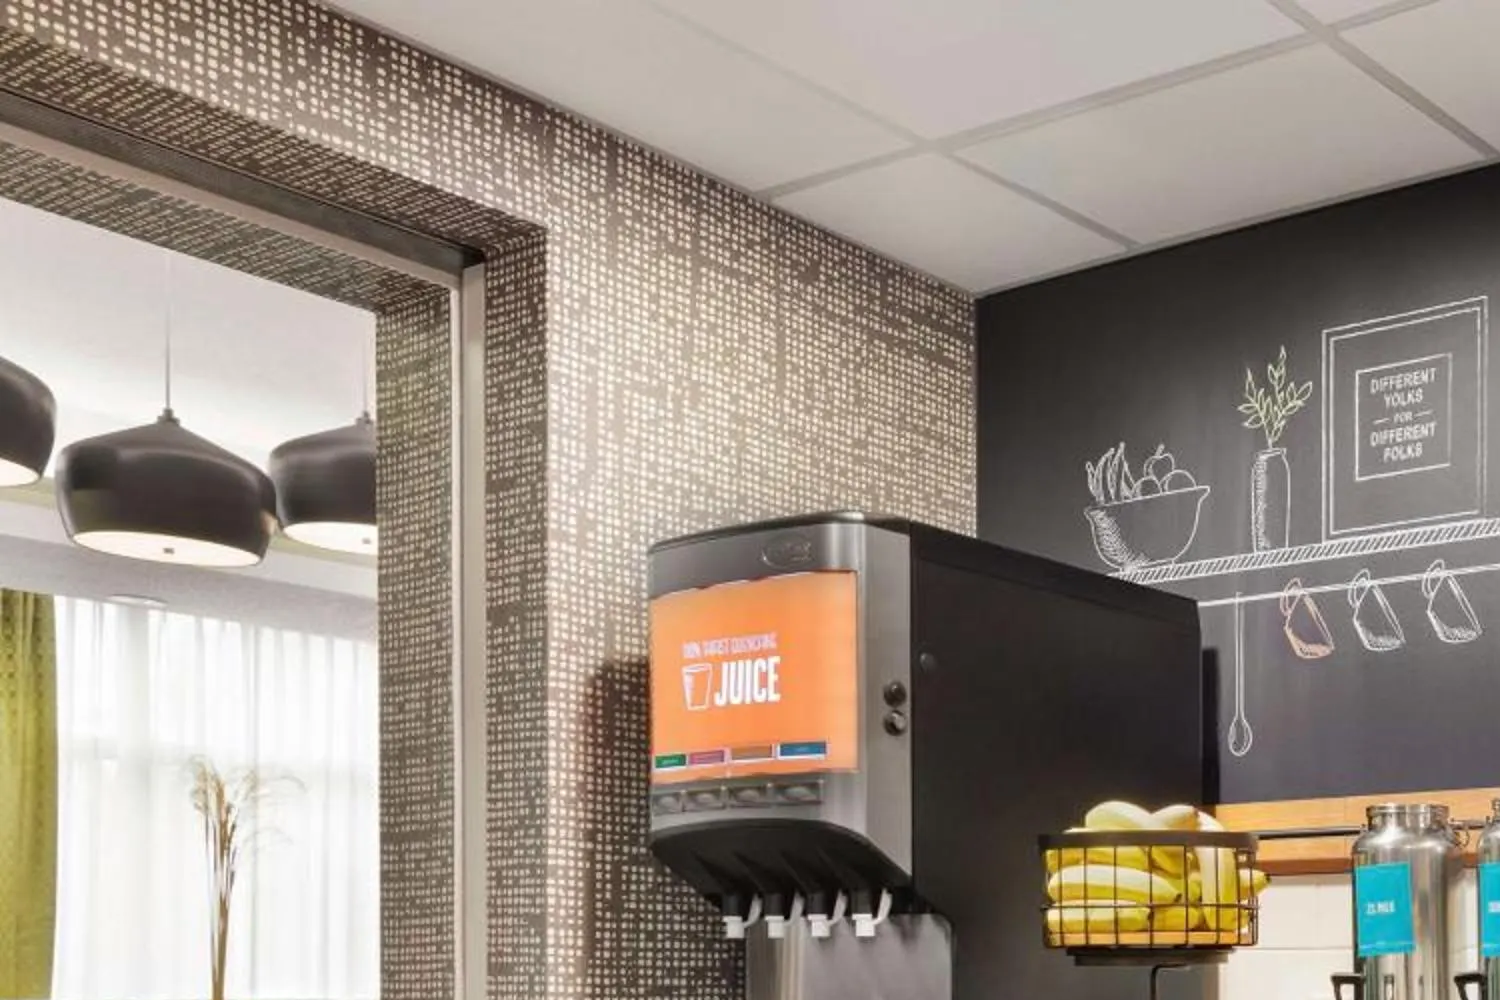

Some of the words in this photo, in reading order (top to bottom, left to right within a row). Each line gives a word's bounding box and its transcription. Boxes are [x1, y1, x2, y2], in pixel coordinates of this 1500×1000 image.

[1370, 367, 1437, 395] DIFFERENT
[1383, 387, 1424, 409] YOLKS
[1393, 411, 1413, 424] FOR
[1370, 421, 1437, 447] DIFFERENT
[1383, 442, 1423, 463] FOLKS
[713, 655, 781, 707] JUICE
